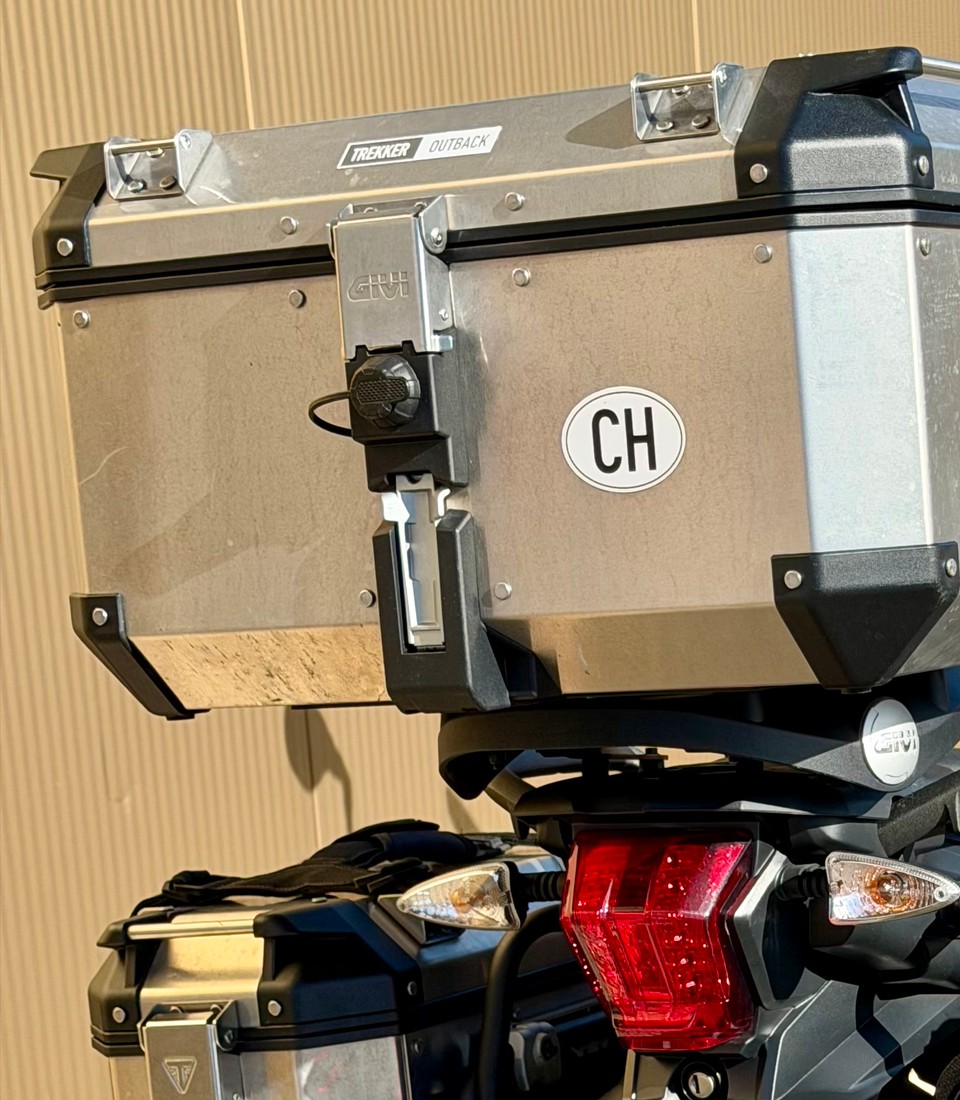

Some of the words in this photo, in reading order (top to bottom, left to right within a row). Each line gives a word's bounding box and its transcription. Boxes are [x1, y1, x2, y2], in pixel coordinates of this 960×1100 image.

[350, 143, 411, 162] TREKKER
[429, 134, 491, 153] OUTBACK
[347, 271, 409, 302] GIVI
[591, 406, 657, 474] CH
[873, 729, 918, 755] GIVI
